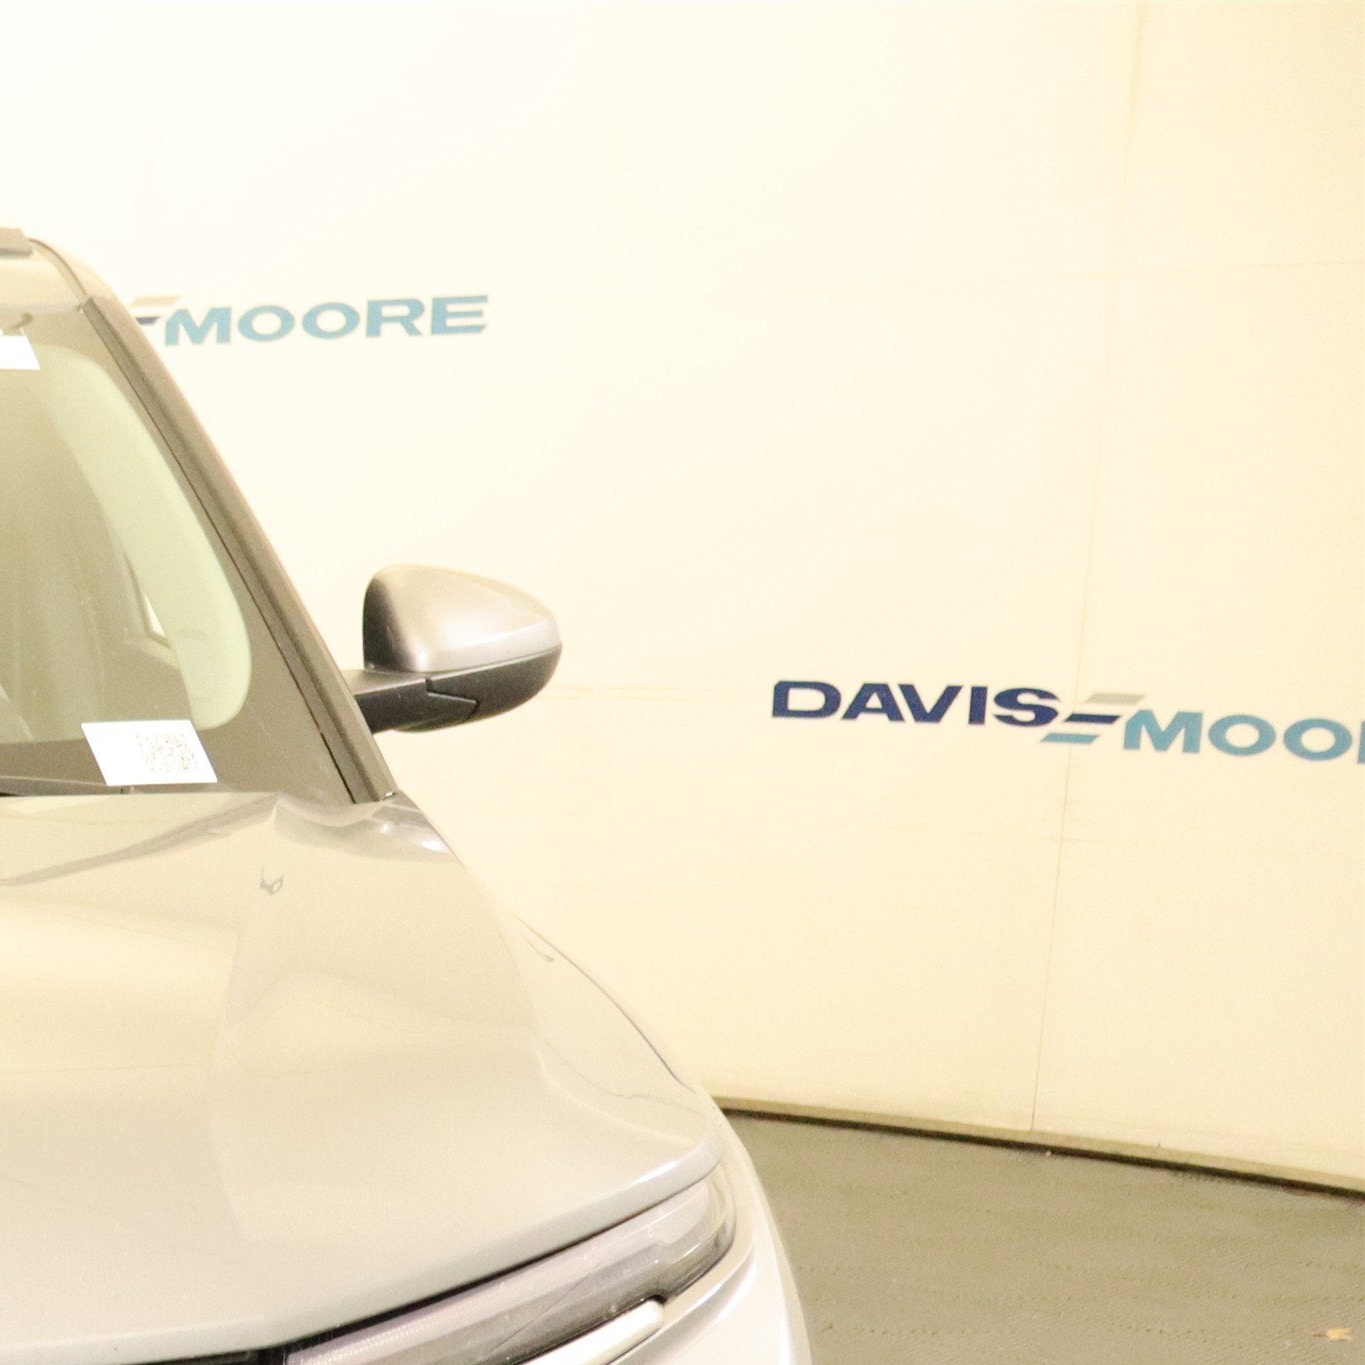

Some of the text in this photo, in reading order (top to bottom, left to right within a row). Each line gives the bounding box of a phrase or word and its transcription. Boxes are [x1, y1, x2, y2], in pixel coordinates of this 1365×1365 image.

[165, 294, 488, 346] MOORE
[771, 679, 1365, 765] DAVIS MOO
